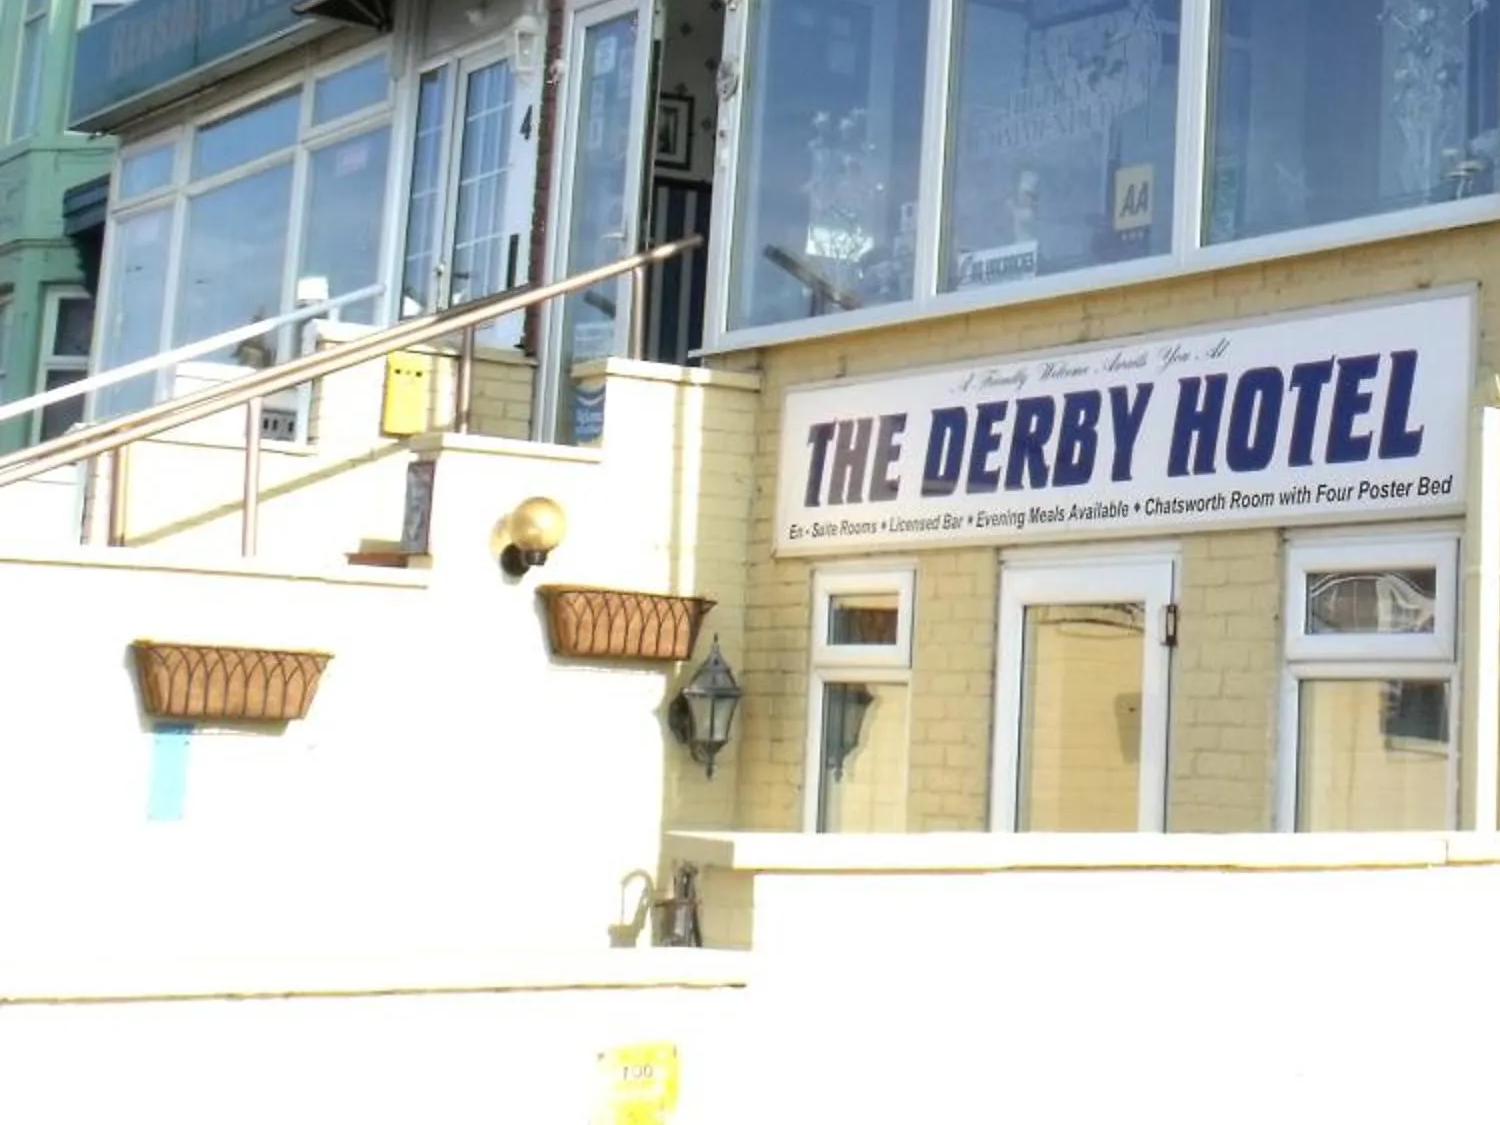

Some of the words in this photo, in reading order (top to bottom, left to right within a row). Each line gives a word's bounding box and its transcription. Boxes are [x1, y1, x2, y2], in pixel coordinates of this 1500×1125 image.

[520, 104, 534, 140] 4
[1119, 181, 1149, 217] AA
[1158, 342, 1189, 374] You
[804, 413, 907, 507] THE
[921, 382, 1155, 498] DERBY
[1168, 350, 1425, 477] HOTEL
[840, 519, 877, 535] Rooms
[889, 513, 941, 532] Licensed
[943, 512, 963, 529] Bar
[975, 509, 1025, 528] Evening
[1028, 506, 1065, 523] Meals
[1067, 500, 1129, 521] Available
[1144, 493, 1226, 516] Chatsworth
[1229, 490, 1275, 509] Room
[1279, 486, 1311, 505] with
[1315, 484, 1353, 504] Four
[1357, 479, 1414, 501] Poster
[1417, 475, 1454, 496] Bed
